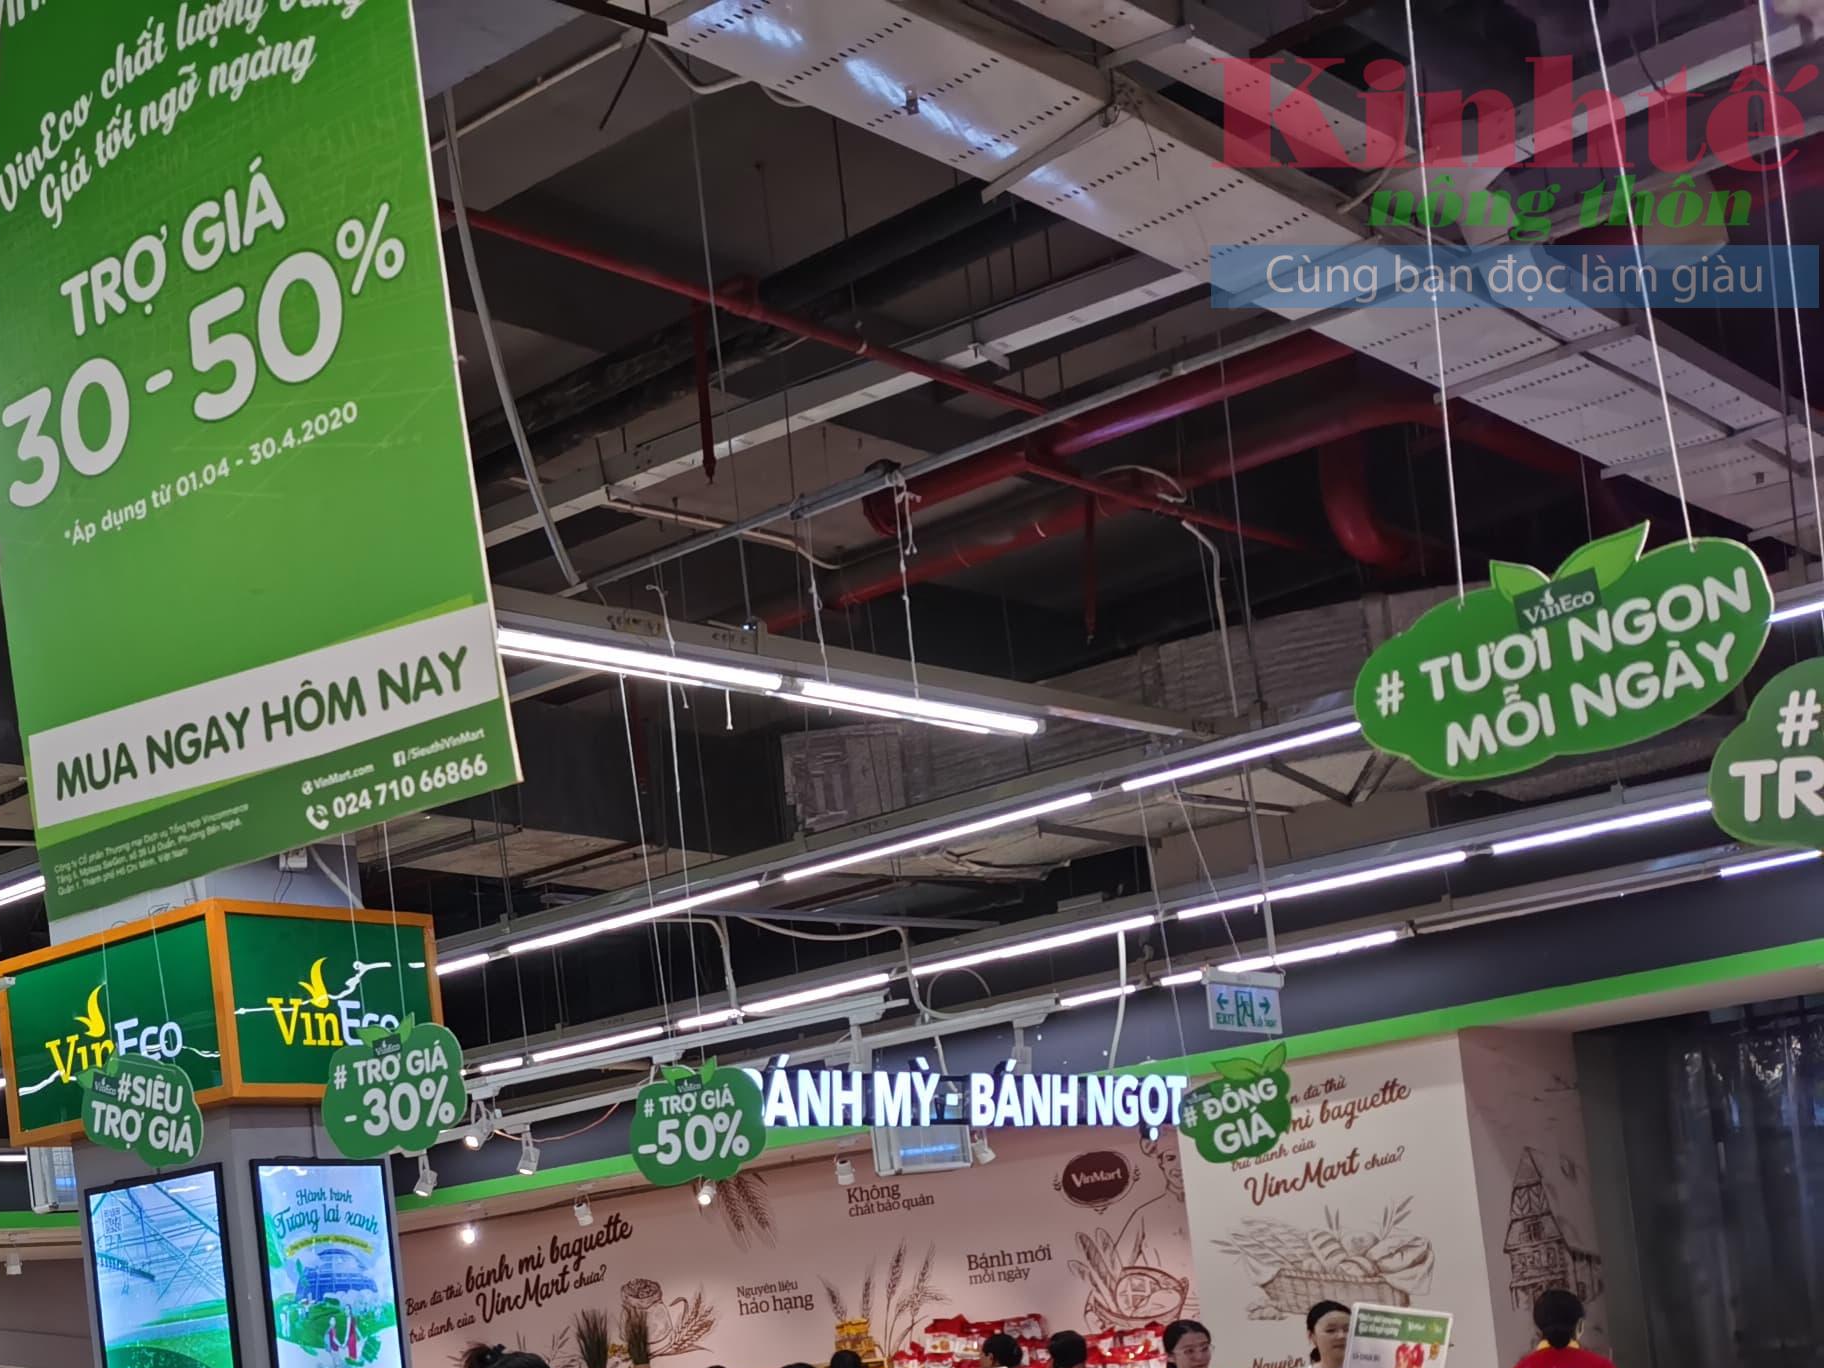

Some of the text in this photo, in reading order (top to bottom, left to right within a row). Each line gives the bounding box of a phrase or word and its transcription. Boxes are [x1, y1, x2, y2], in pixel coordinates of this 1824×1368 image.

[100, 16, 168, 99] chất
[40, 34, 318, 229] Giá tốt ngỡ ngàng
[60, 156, 287, 337] TRỢ GIÁ
[101, 496, 147, 532] dụng
[151, 485, 175, 509] từ
[176, 457, 231, 498] 01.04
[248, 400, 359, 466] 30.4.2020
[1522, 588, 1596, 624] VinEco
[1419, 567, 1751, 702] TƯƠI NGON
[56, 645, 468, 801] MUA NGAY HÔM NAY
[1446, 632, 1736, 768] MỖI NGÀY
[313, 763, 375, 790] VinMart.com
[332, 753, 489, 819] 024 710 66866
[353, 1040, 449, 1086] TRỢ GIÁ
[659, 1083, 735, 1117] TRỢ GIÁ
[743, 1054, 1187, 1141] ÁNH MỲ BÁNH NGỌT
[1202, 1077, 1278, 1122] ĐỒNG
[1320, 1077, 1412, 1130] baguette
[91, 1100, 194, 1158] TRỢ GIÁ
[638, 1109, 750, 1166] -50%
[1213, 1105, 1276, 1154] GIÁ
[1292, 1138, 1316, 1155] của
[846, 1183, 901, 1205] Không
[1071, 1166, 1123, 1188] VinMart
[1244, 1147, 1360, 1206] VinMart
[323, 1203, 341, 1223] lai
[344, 1211, 379, 1235] xanh
[848, 1200, 876, 1218] chất
[406, 1297, 428, 1316] Bạn
[465, 1254, 514, 1294] bánh
[518, 1246, 545, 1275] mì
[549, 1212, 633, 1270] baguette
[966, 1243, 1053, 1271] Bánh mới
[997, 1266, 1031, 1284] ngày
[736, 1281, 777, 1299] Nguyên
[772, 1292, 815, 1314] hạng
[427, 1319, 455, 1340] danh
